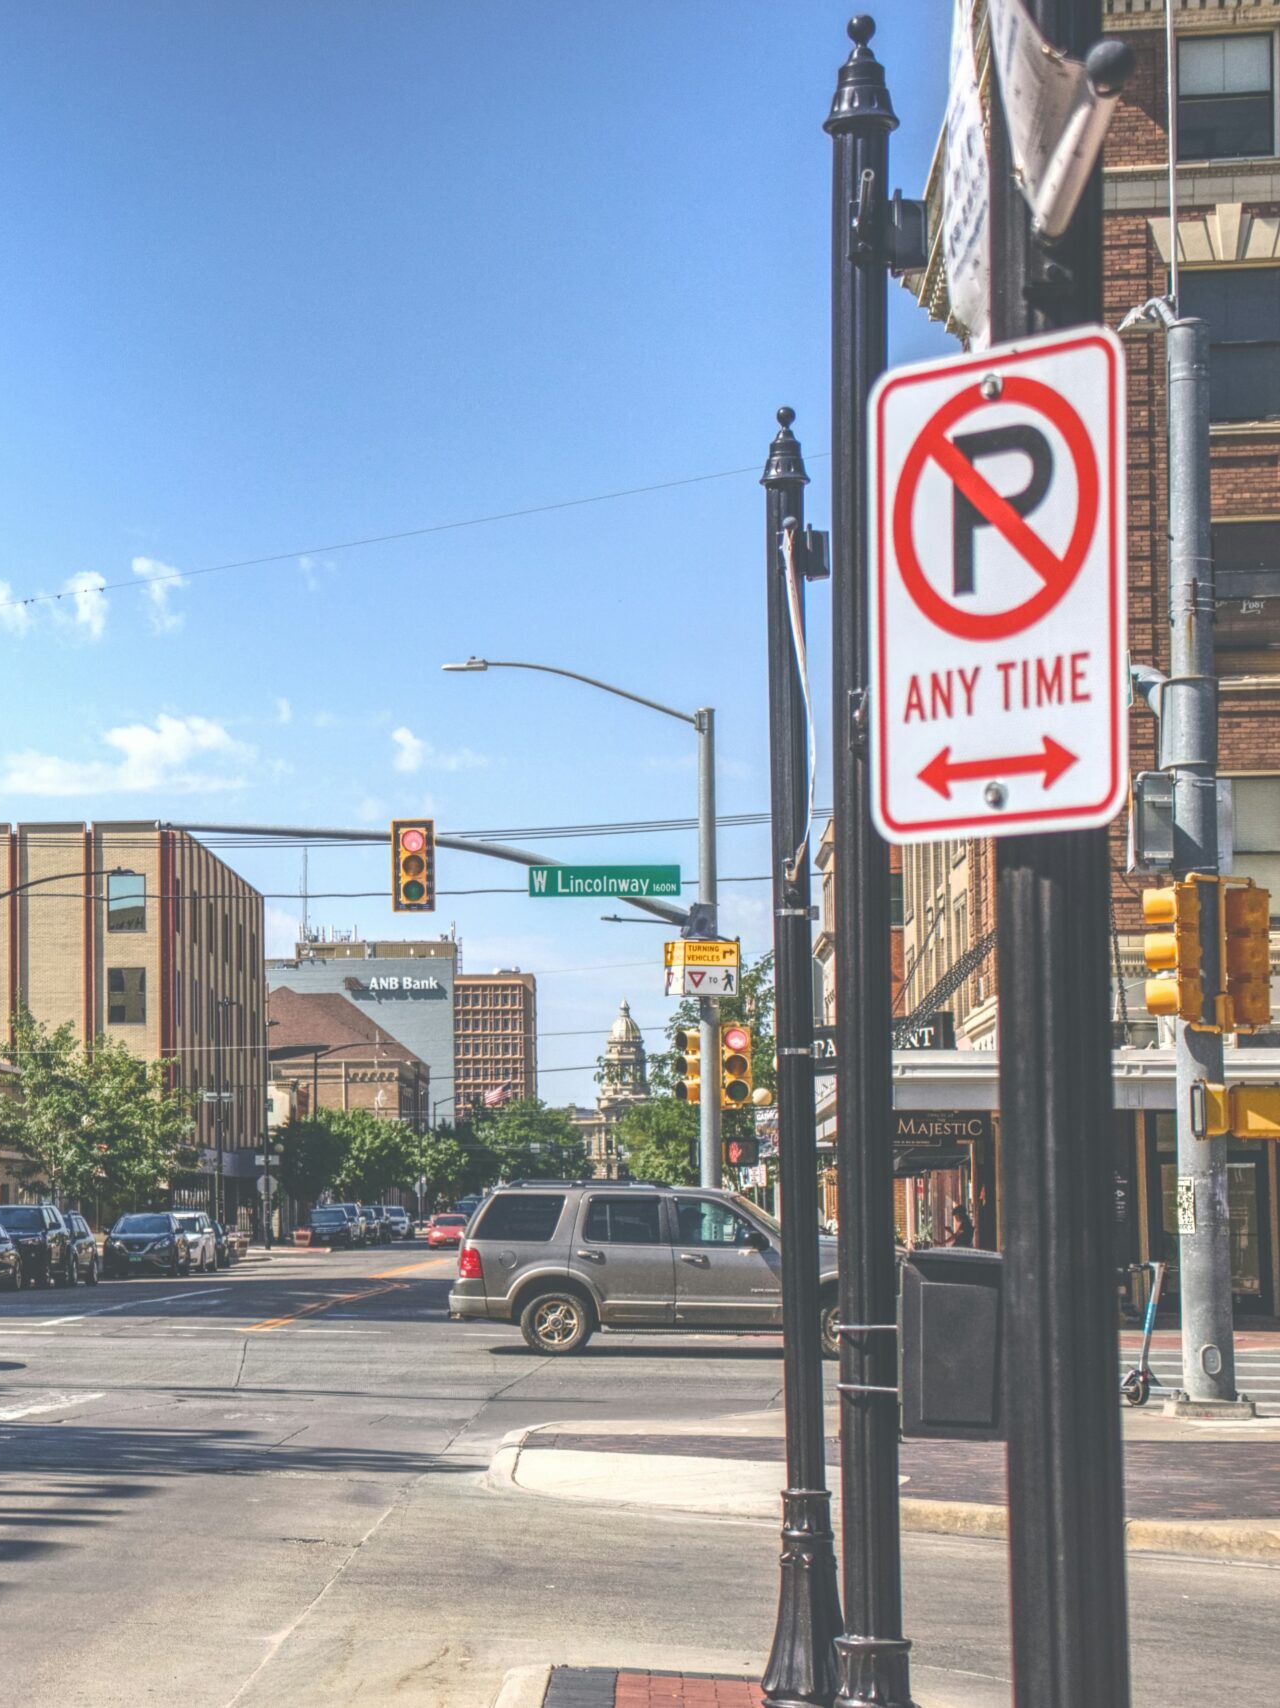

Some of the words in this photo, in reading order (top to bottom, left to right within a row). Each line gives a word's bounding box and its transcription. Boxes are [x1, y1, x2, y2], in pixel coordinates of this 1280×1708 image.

[904, 666, 981, 723] ANY
[996, 651, 1092, 711] TIME
[533, 870, 548, 893] W
[557, 870, 650, 895] Lincolnway
[653, 883, 677, 892] 1600N
[369, 976, 400, 990] ANB
[402, 976, 438, 990] Bank
